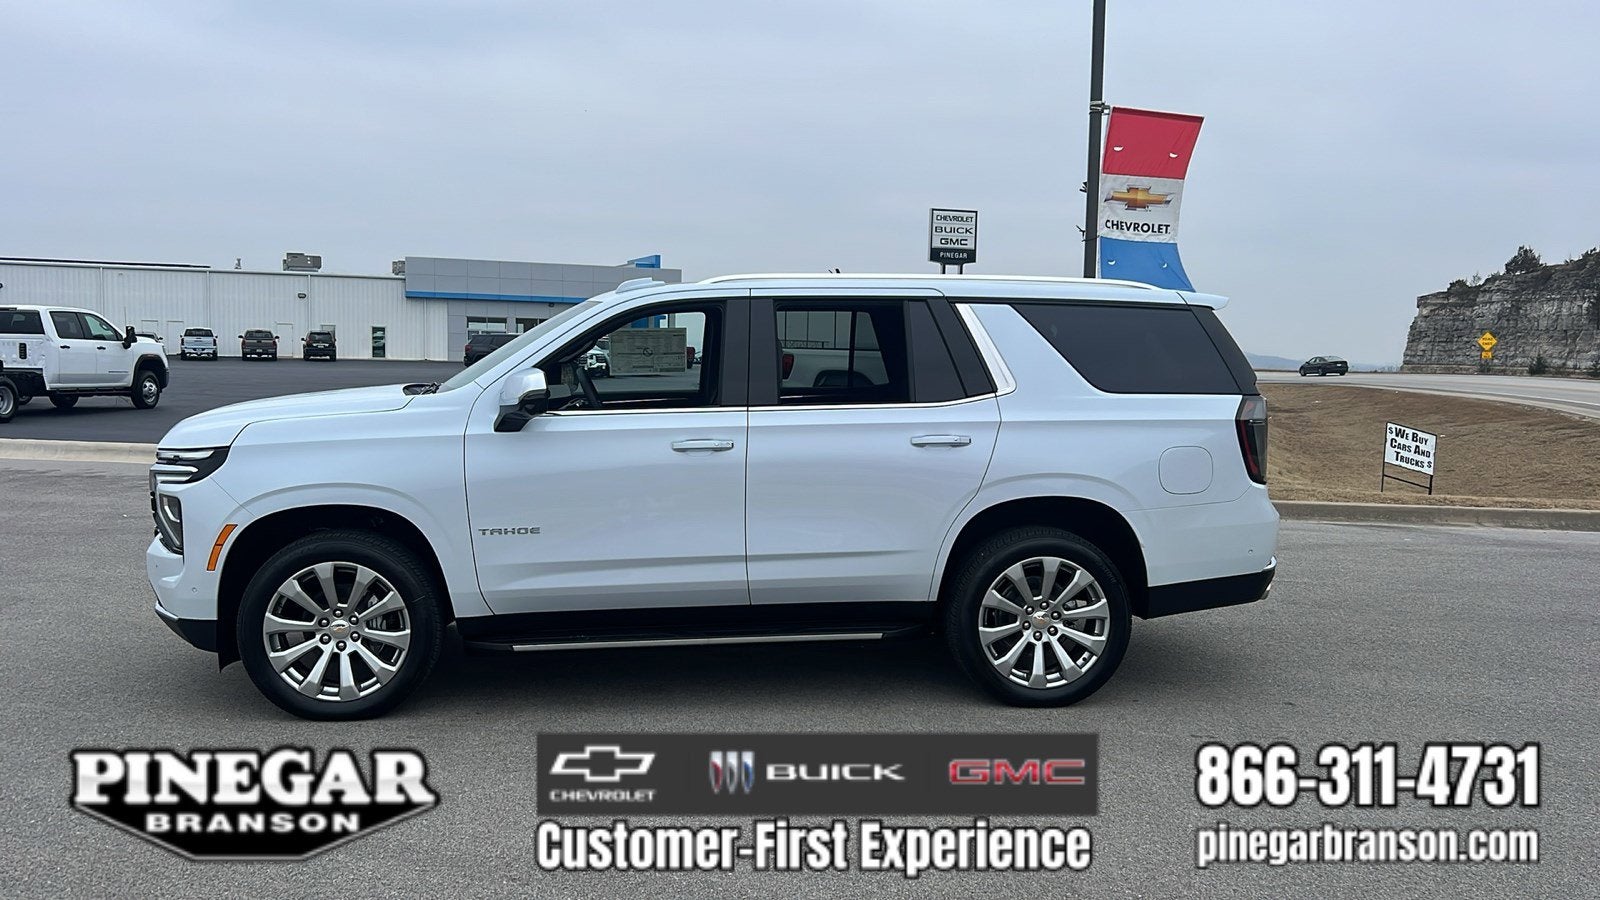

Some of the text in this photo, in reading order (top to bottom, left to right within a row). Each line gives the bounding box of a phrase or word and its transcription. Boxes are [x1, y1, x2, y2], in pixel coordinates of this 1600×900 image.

[935, 226, 973, 234] BUICK
[940, 238, 968, 246] GMC
[478, 527, 541, 536] TAHOE
